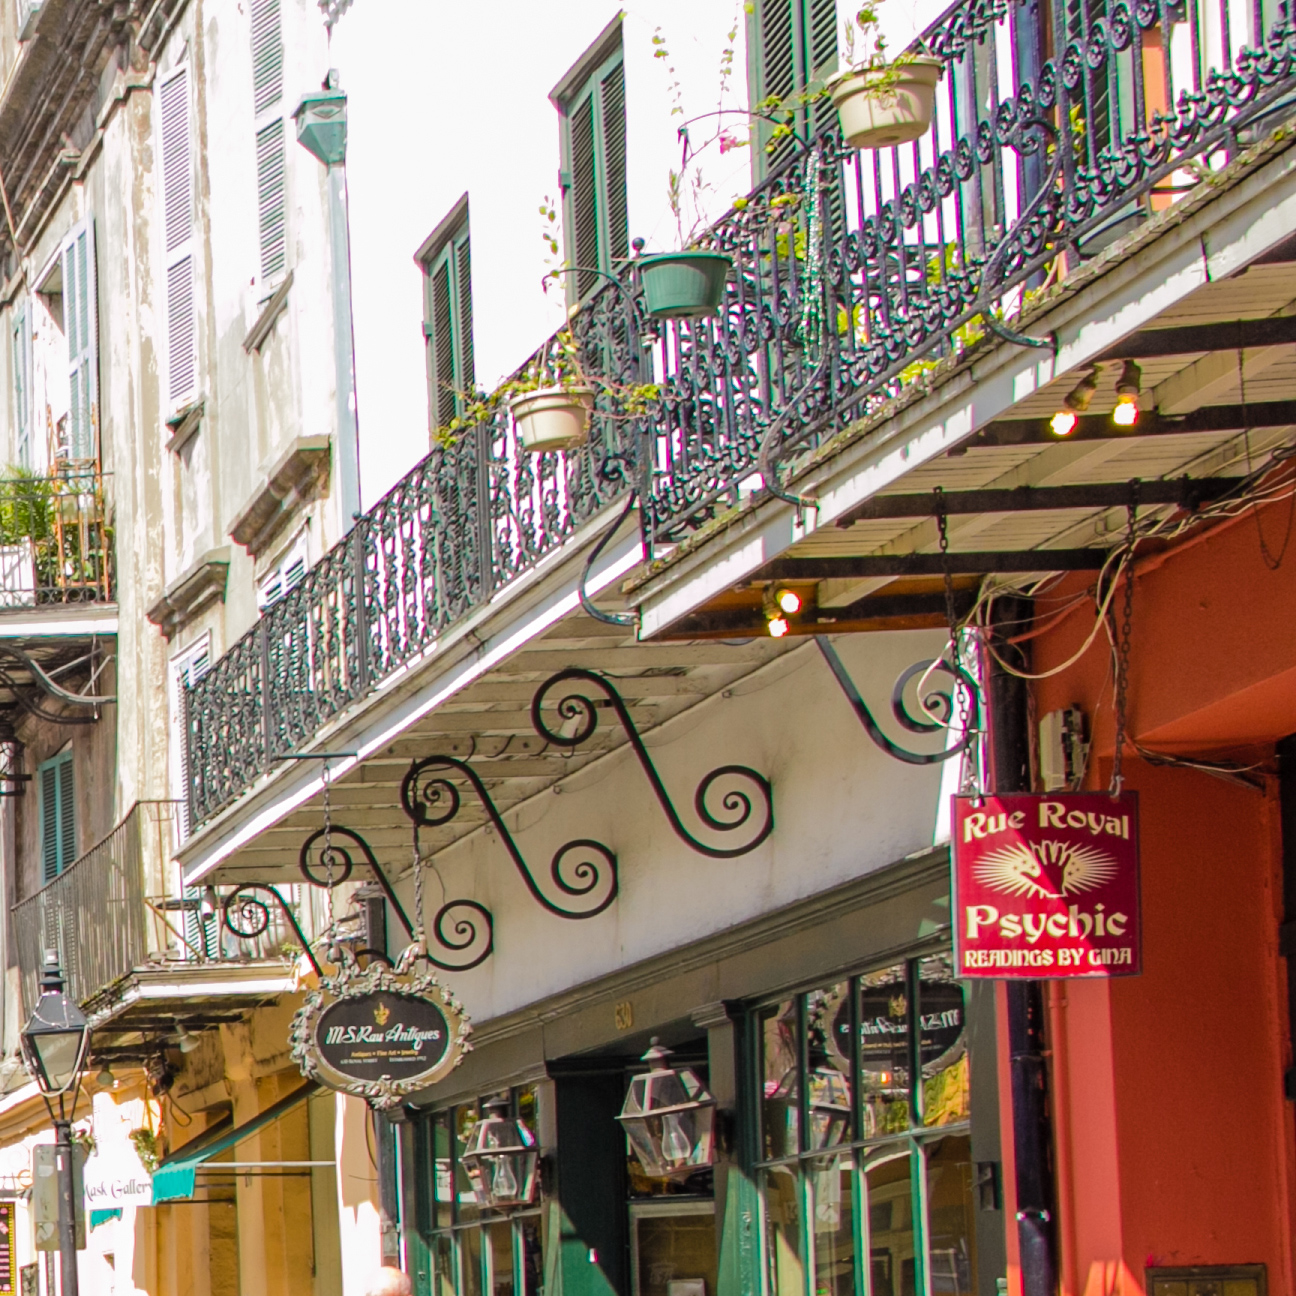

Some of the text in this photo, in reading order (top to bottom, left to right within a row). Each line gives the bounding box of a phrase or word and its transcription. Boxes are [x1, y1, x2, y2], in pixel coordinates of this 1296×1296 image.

[963, 802, 1129, 843] Rue Royal
[966, 903, 1128, 944] Psychic
[965, 947, 1132, 967] READINGS BY GINA
[615, 1001, 633, 1030] 630
[385, 1022, 441, 1050] Antiques
[85, 1181, 108, 1202] ask
